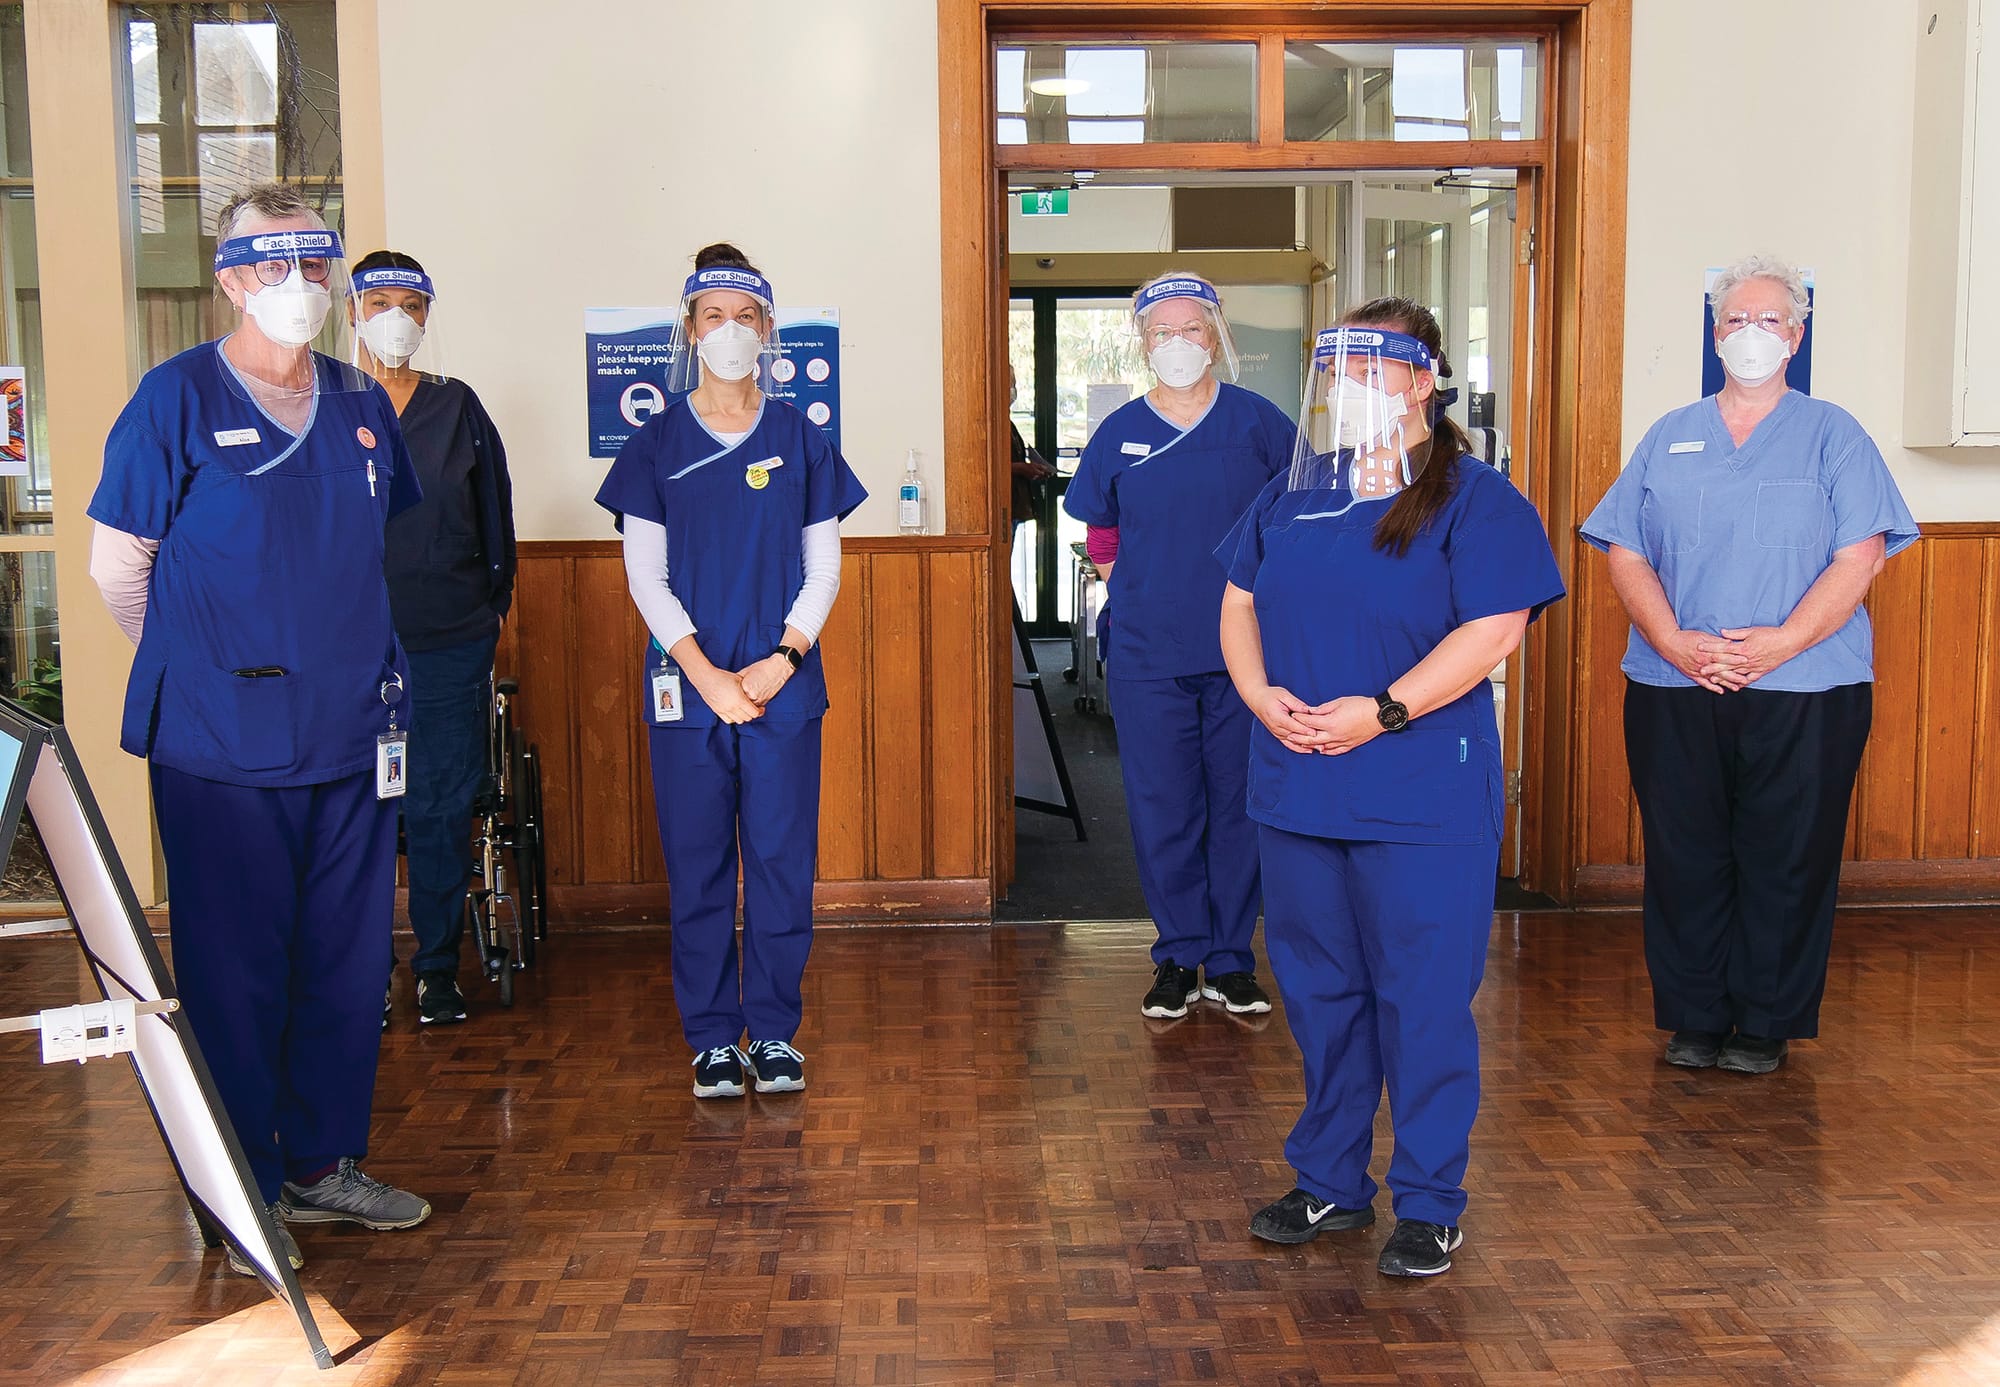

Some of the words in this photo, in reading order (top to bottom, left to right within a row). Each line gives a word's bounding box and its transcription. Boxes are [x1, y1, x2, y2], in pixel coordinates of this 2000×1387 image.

[263, 238, 291, 249] Face
[294, 236, 326, 247] Shield
[370, 272, 390, 280] Face
[391, 271, 417, 281] Shield
[705, 272, 727, 280] Face
[729, 272, 756, 285] Shield
[1151, 285, 1170, 295] Face
[1171, 282, 1197, 290] Shield
[1319, 334, 1338, 345] Face
[597, 343, 611, 352] For
[613, 344, 635, 354] your
[637, 343, 687, 354] protecton
[597, 354, 627, 366] please
[628, 354, 652, 366] keep
[653, 356, 676, 366] your
[597, 366, 623, 375] mask
[623, 367, 637, 375] on
[784, 390, 797, 399] help
